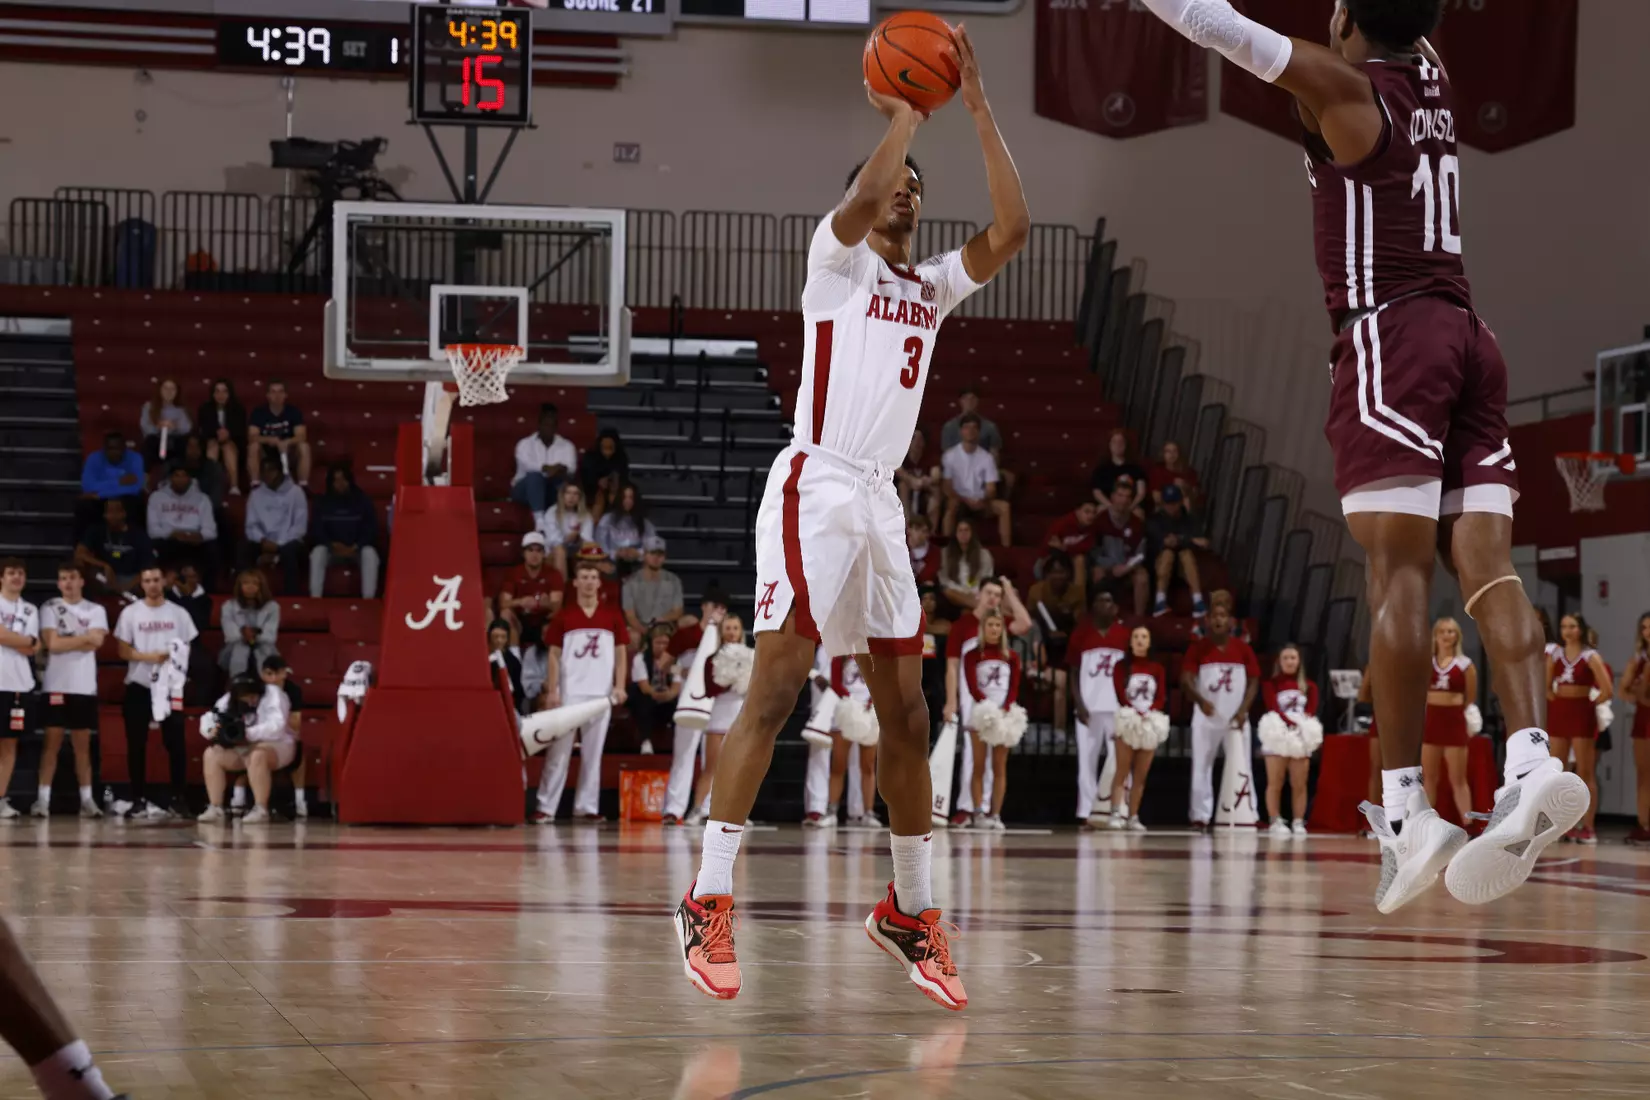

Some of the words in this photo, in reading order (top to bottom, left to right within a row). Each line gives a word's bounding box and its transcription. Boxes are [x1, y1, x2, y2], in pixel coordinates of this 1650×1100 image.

[247, 26, 331, 65] 4:39
[342, 41, 367, 57] SET
[391, 37, 398, 64] 1
[448, 20, 517, 50] 4:39
[461, 54, 505, 110] 15
[1411, 153, 1462, 254] 10
[900, 336, 924, 389] 3
[405, 575, 464, 630] A
